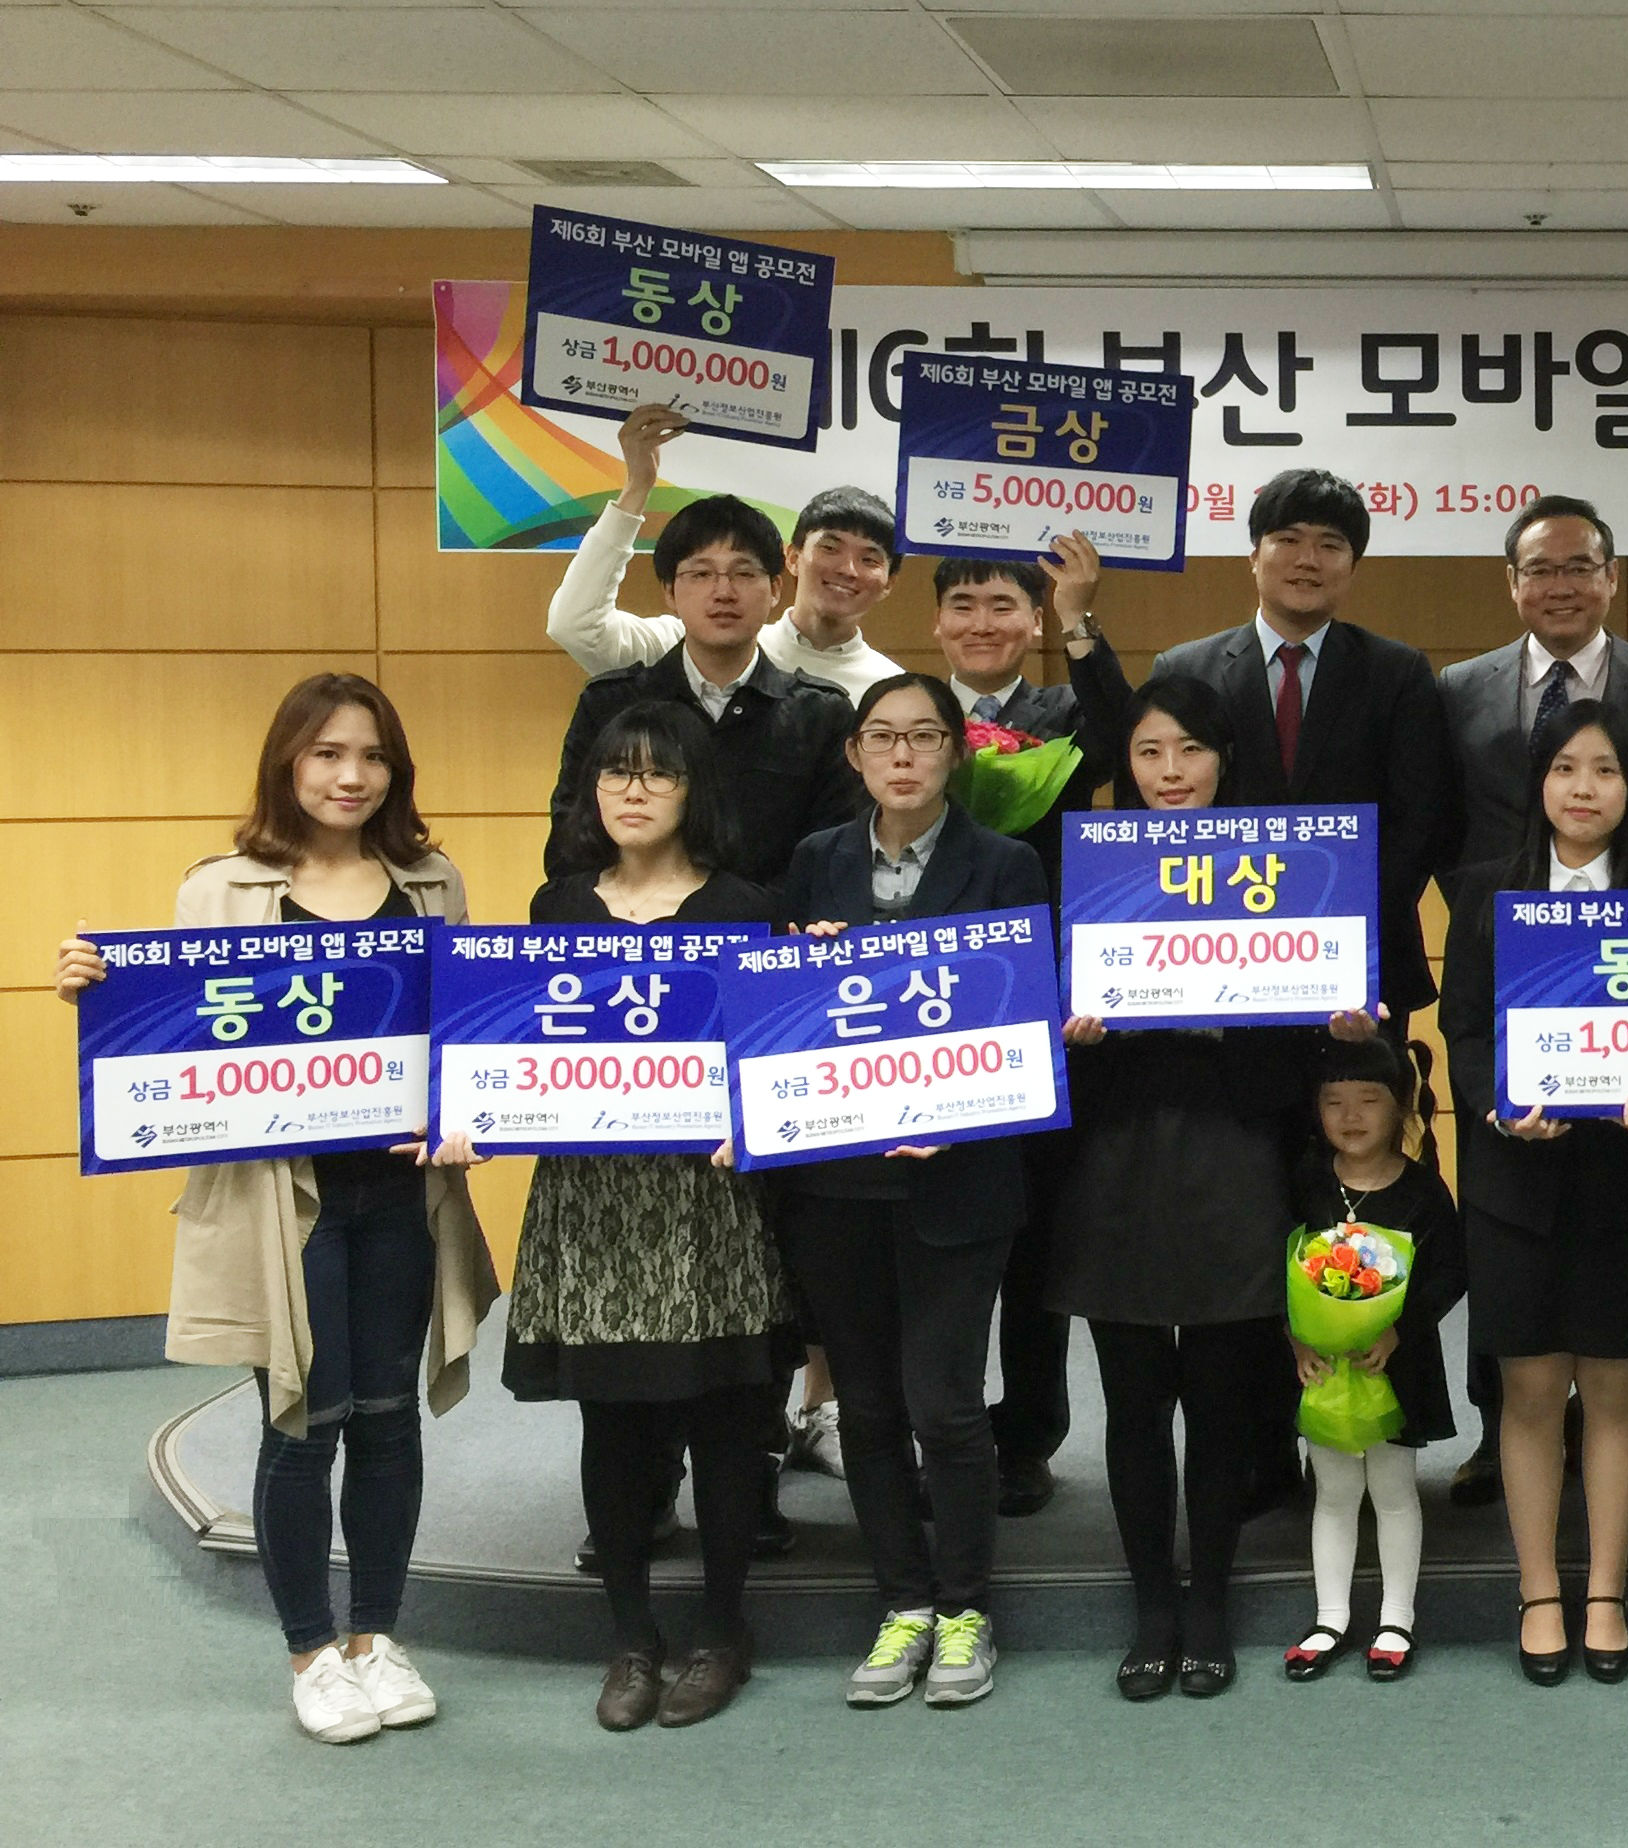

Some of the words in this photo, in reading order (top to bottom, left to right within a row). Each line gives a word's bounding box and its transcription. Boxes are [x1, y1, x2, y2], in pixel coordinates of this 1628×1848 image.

[550, 219, 605, 248] 제6회
[612, 230, 654, 258] 부산
[659, 238, 721, 270] 모바일
[728, 250, 749, 274] 앱
[754, 255, 816, 286] 공모전
[562, 338, 597, 359] 상금
[586, 380, 639, 398] 부산광역시
[920, 362, 974, 387] 제6회
[980, 368, 1022, 392] 부산
[1027, 372, 1086, 398] 모바일
[1092, 379, 1112, 400] 앱
[1118, 380, 1177, 406] 공모전
[933, 480, 966, 500] 상금
[958, 520, 1010, 534] 부산광역시
[1080, 821, 1138, 843] 제6회
[1144, 820, 1188, 845] 부산
[1194, 818, 1259, 843] 모바일
[1265, 816, 1287, 840] 앱
[1293, 815, 1358, 841] 공모전
[1513, 901, 1572, 926] 제6회
[1578, 901, 1624, 927] 부산
[101, 941, 170, 968] 제6회
[178, 941, 230, 966] 부산
[238, 935, 313, 961] 모바일
[321, 932, 345, 958] 앱
[352, 929, 425, 958] 공모전
[451, 937, 514, 960] 제6회
[520, 937, 568, 962] 부산
[573, 936, 643, 961] 모바일
[650, 937, 673, 961] 앱
[739, 949, 800, 974] 제6회
[806, 939, 854, 970] 부산
[859, 929, 928, 960] 모바일
[934, 926, 958, 952] 앱
[963, 918, 1033, 951] 공모전
[1100, 946, 1134, 967] 상금
[1128, 987, 1183, 1000] 부산광역시
[1535, 1031, 1573, 1053] 상금
[471, 1069, 509, 1090] 상금
[771, 1076, 809, 1100] 상금
[1565, 1076, 1621, 1088] 부산광역시
[128, 1080, 171, 1102] 상금
[162, 1120, 228, 1138] 부산광역시
[500, 1113, 559, 1125] 부산광역시
[804, 1113, 864, 1131] 부산광역시
